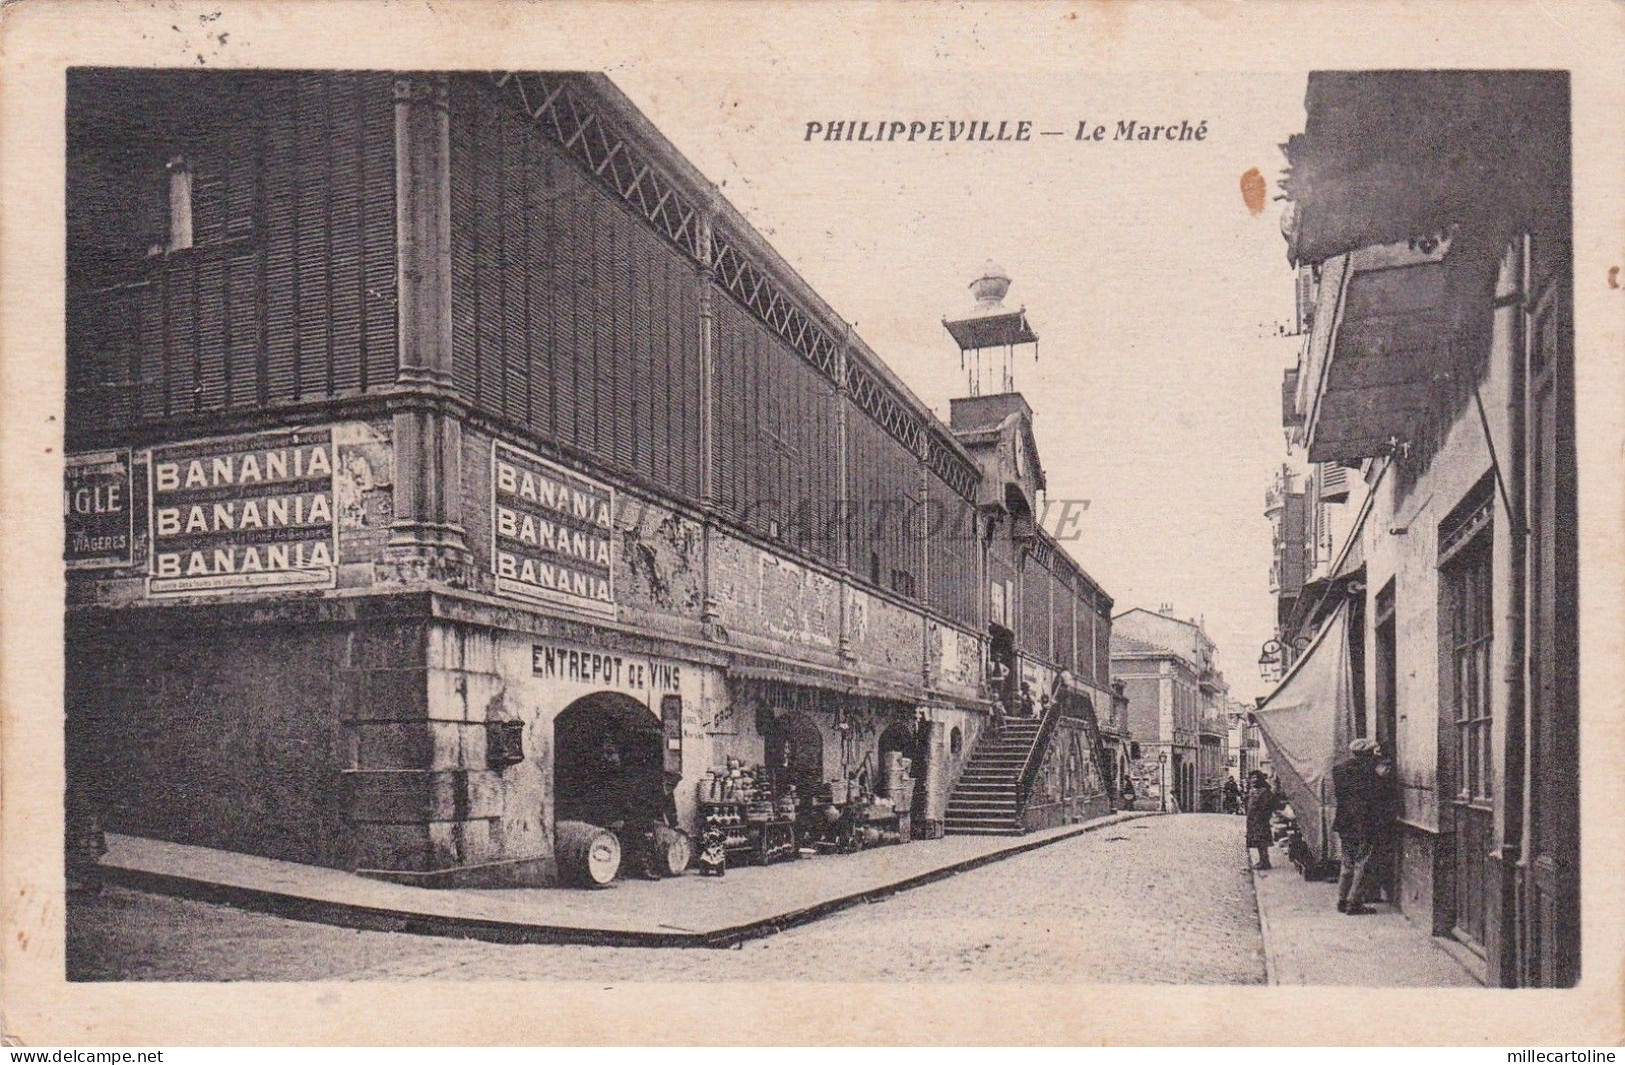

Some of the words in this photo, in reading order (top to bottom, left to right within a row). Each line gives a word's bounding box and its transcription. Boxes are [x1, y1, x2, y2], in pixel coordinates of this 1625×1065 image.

[156, 446, 332, 491] BANANIA
[156, 494, 332, 536] BANANIA
[498, 462, 611, 527] BANANIA
[156, 541, 332, 578] BANANIA
[498, 507, 611, 566] BANANIA
[498, 552, 611, 602] BANANIA
[531, 644, 622, 687] ENTREPOT
[628, 664, 644, 689] DE
[649, 662, 680, 691] VINS
